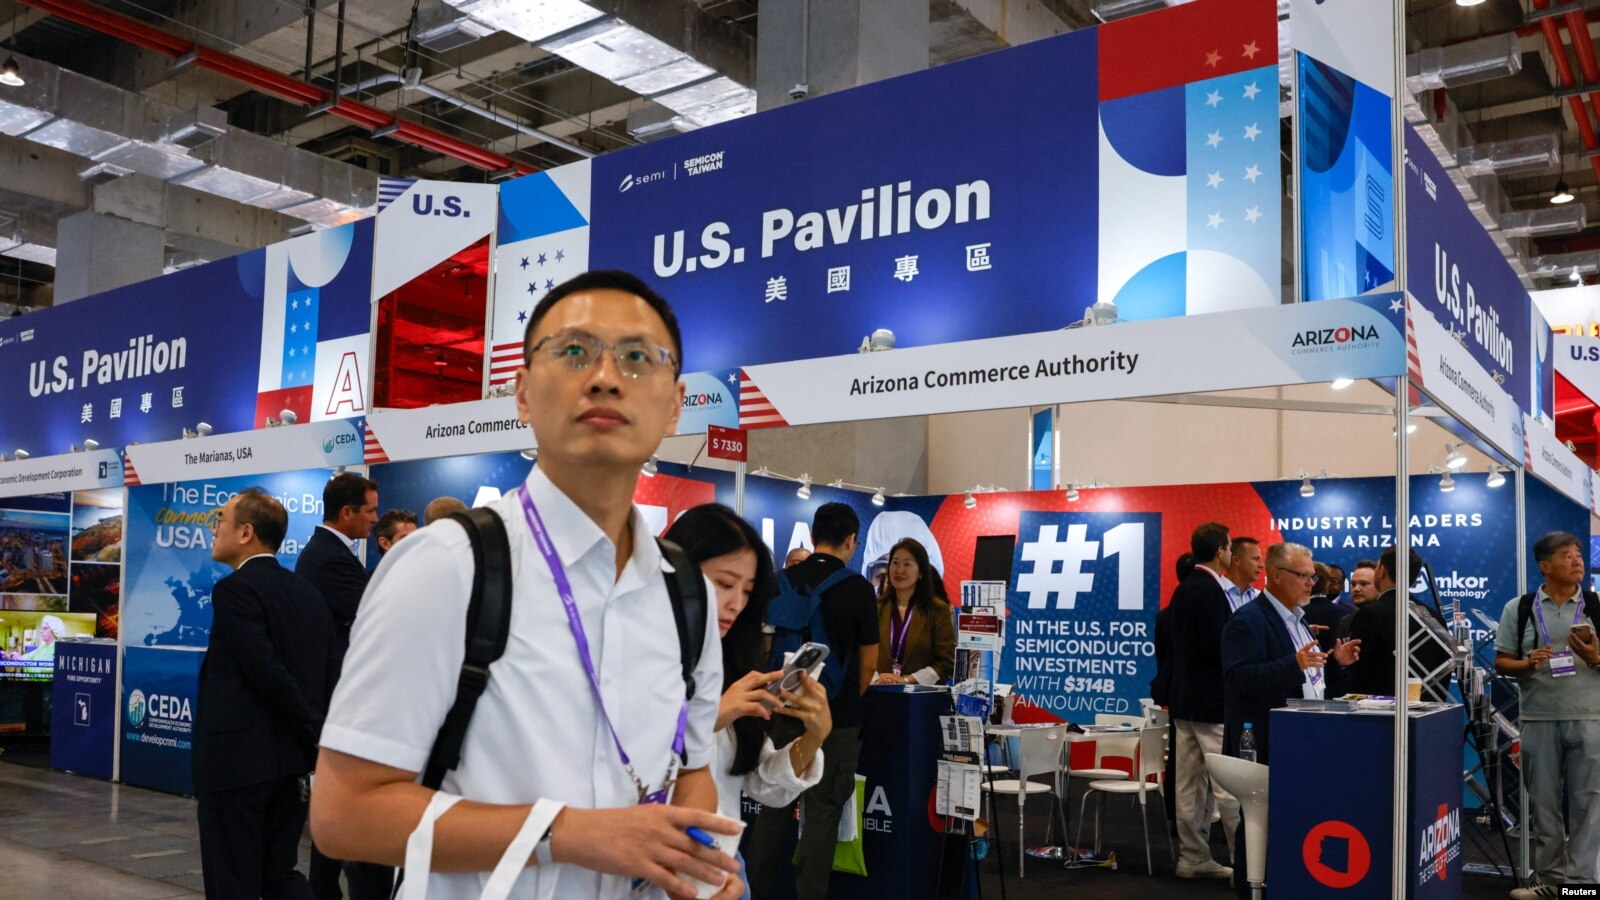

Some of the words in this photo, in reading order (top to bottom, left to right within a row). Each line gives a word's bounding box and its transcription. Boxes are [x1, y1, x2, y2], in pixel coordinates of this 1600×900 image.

[684, 151, 724, 169] SEMICON
[688, 160, 723, 176] TAIWAN
[636, 171, 665, 185] semi
[413, 193, 470, 218] U.S.
[652, 221, 745, 277] U.S.
[761, 178, 991, 258] Pavilion
[765, 243, 992, 303] 美國專區
[1435, 242, 1464, 326] U.S.
[1466, 281, 1513, 375] Pavilion
[1292, 324, 1380, 347] ARIZONA
[1292, 346, 1333, 355] COMMERCE
[1336, 342, 1379, 351] AUTHORITY
[29, 355, 74, 397] U.S.
[81, 334, 187, 388] Pavilion
[850, 375, 919, 396] Arizona
[924, 365, 1030, 389] Commerce
[1035, 350, 1139, 378] Authority
[326, 352, 364, 415] A
[1440, 354, 1457, 386] Arizona
[1458, 370, 1479, 404] Commerce
[681, 392, 722, 407] RIZONA
[335, 433, 357, 444] CEDA
[425, 424, 465, 439] Arizona
[713, 438, 719, 449] S
[721, 440, 743, 453] 7330
[185, 453, 198, 465] The
[199, 450, 235, 463] Marianas,
[236, 446, 253, 459] USA
[18, 471, 51, 484] Development
[51, 467, 83, 480] Corporation
[1270, 516, 1372, 531] INDUSTRY
[1382, 513, 1483, 529] LADERS
[156, 525, 207, 549] USA
[1313, 536, 1333, 548] IN
[1343, 534, 1441, 548] ARIZNA
[1016, 522, 1145, 610] #1
[1435, 571, 1488, 588] mkor
[1439, 588, 1488, 599] echnology
[1016, 620, 1033, 634] IN
[1036, 620, 1070, 635] THE
[1074, 621, 1105, 636] U.S.
[1109, 622, 1147, 637] FOR
[1015, 639, 1156, 656] SEMICONDUCTO
[59, 655, 111, 674] MICHIGAN
[1015, 657, 1137, 675] INVESTMENTS
[76, 676, 101, 684] OPPORTUNITY
[1016, 675, 1060, 691] WITH
[1064, 675, 1115, 693] $314B
[148, 694, 192, 721] CEDA
[1015, 694, 1129, 713] ANNOUNCED
[126, 732, 192, 750] www.developcnmi.com
[864, 818, 892, 833] IBLE
[1419, 808, 1460, 867] ARIZONA
